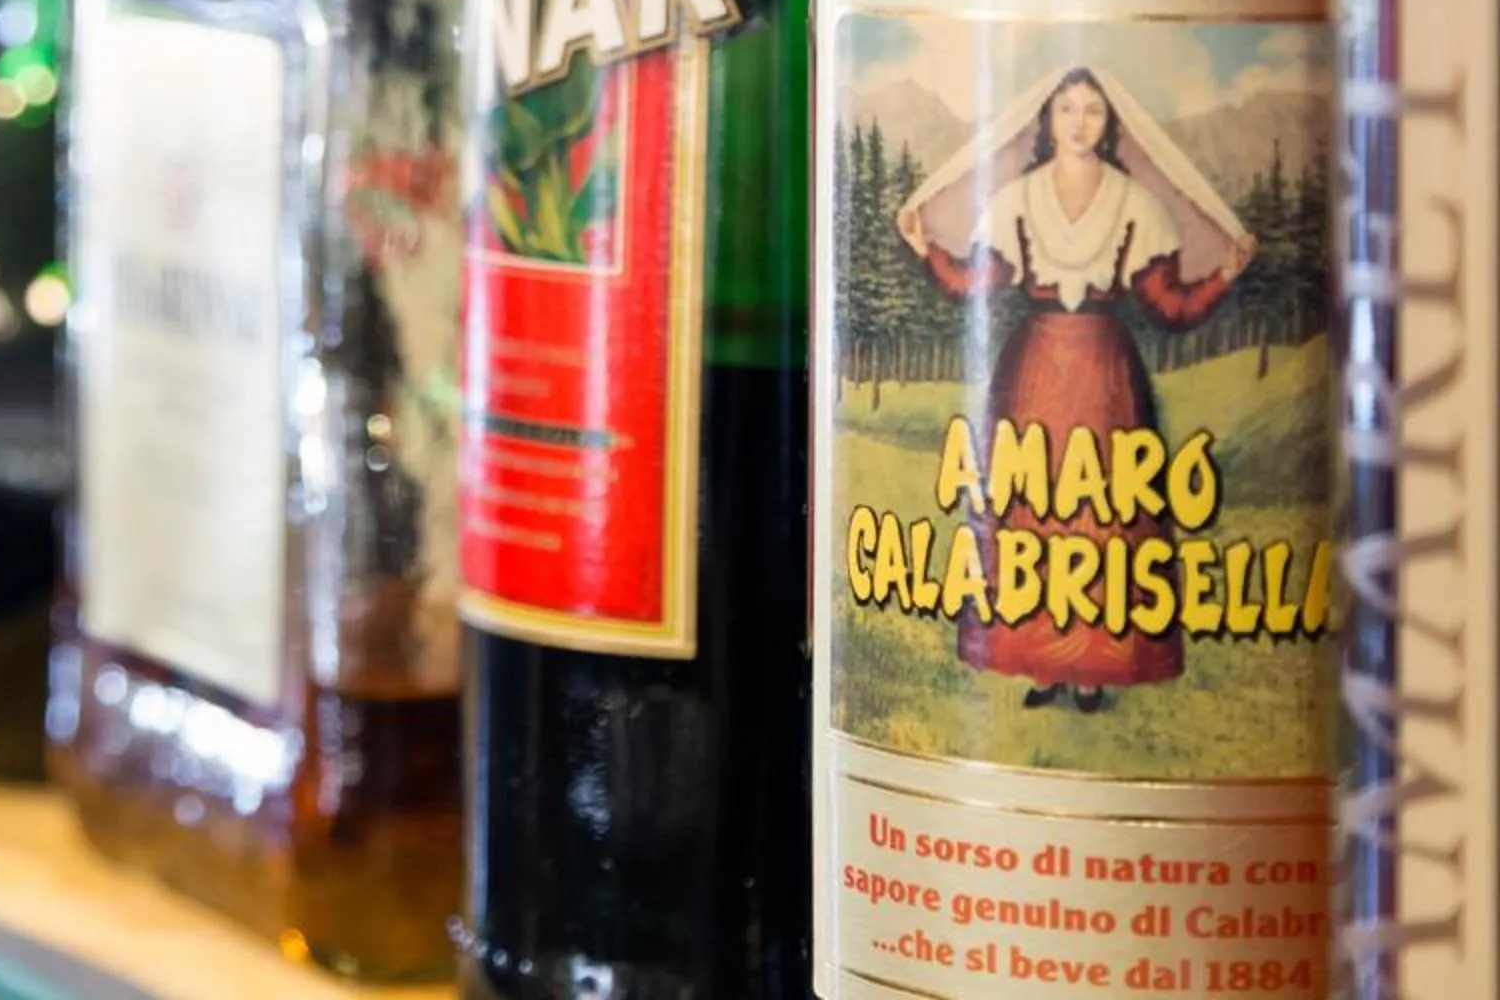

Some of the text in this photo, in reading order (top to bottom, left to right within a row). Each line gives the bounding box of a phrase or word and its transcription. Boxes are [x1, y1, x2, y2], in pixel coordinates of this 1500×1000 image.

[937, 415, 1219, 531] AMARO
[869, 812, 1318, 886] Un sorso di natura con
[843, 864, 1326, 939] sapore genuino di Calabr
[872, 929, 1314, 992] ...che si beve dal 1884
